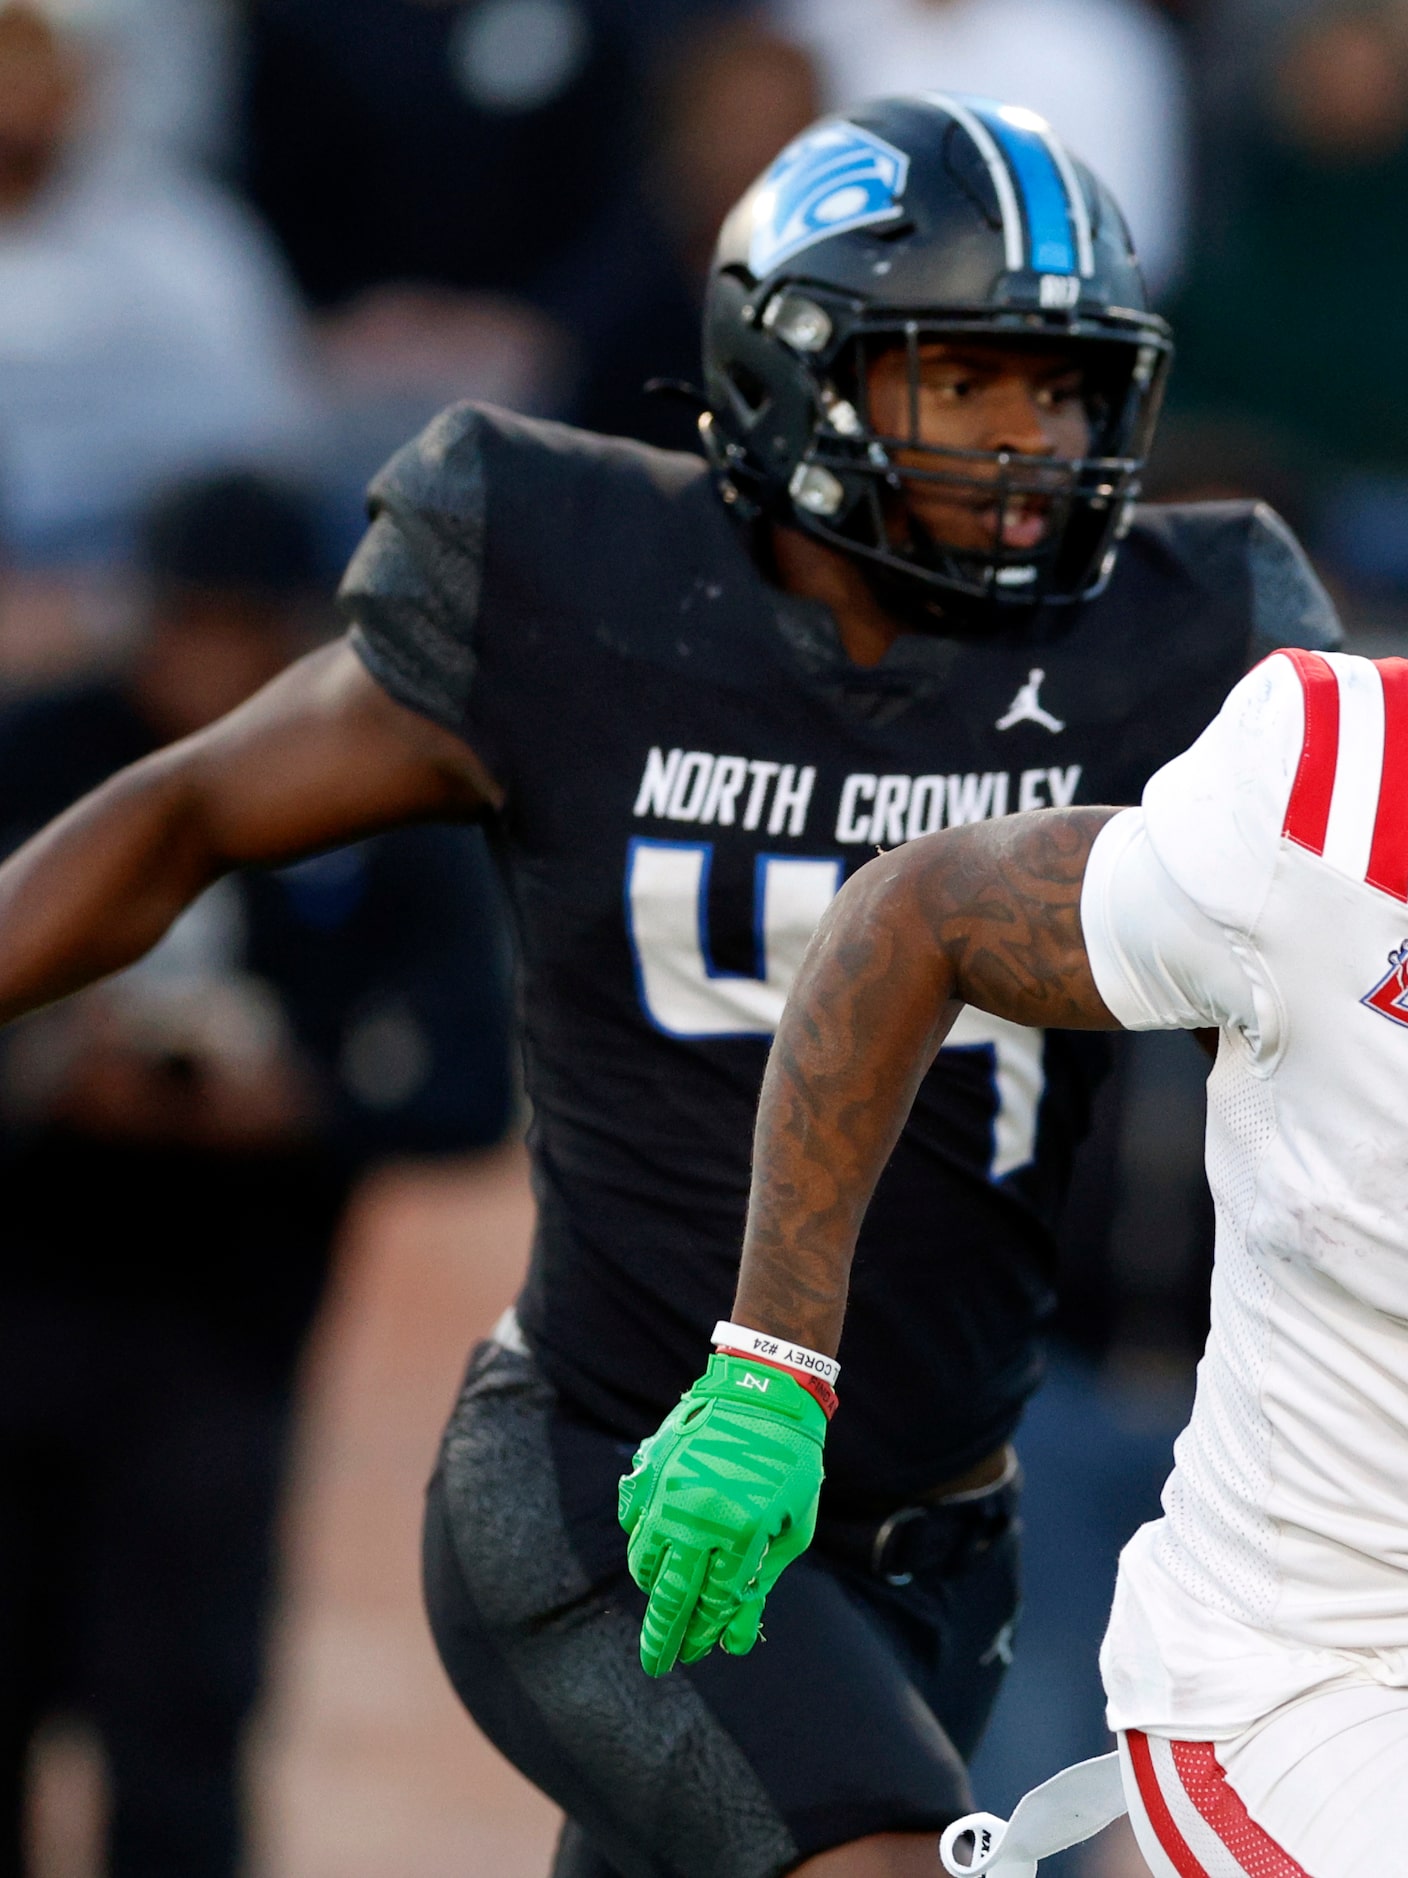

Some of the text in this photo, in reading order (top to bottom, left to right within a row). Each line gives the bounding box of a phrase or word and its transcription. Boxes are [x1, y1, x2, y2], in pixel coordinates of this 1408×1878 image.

[633, 746, 1082, 846] NORTH CROWLEY
[752, 1338, 779, 1356] #24
[784, 1349, 832, 1376] COREY
